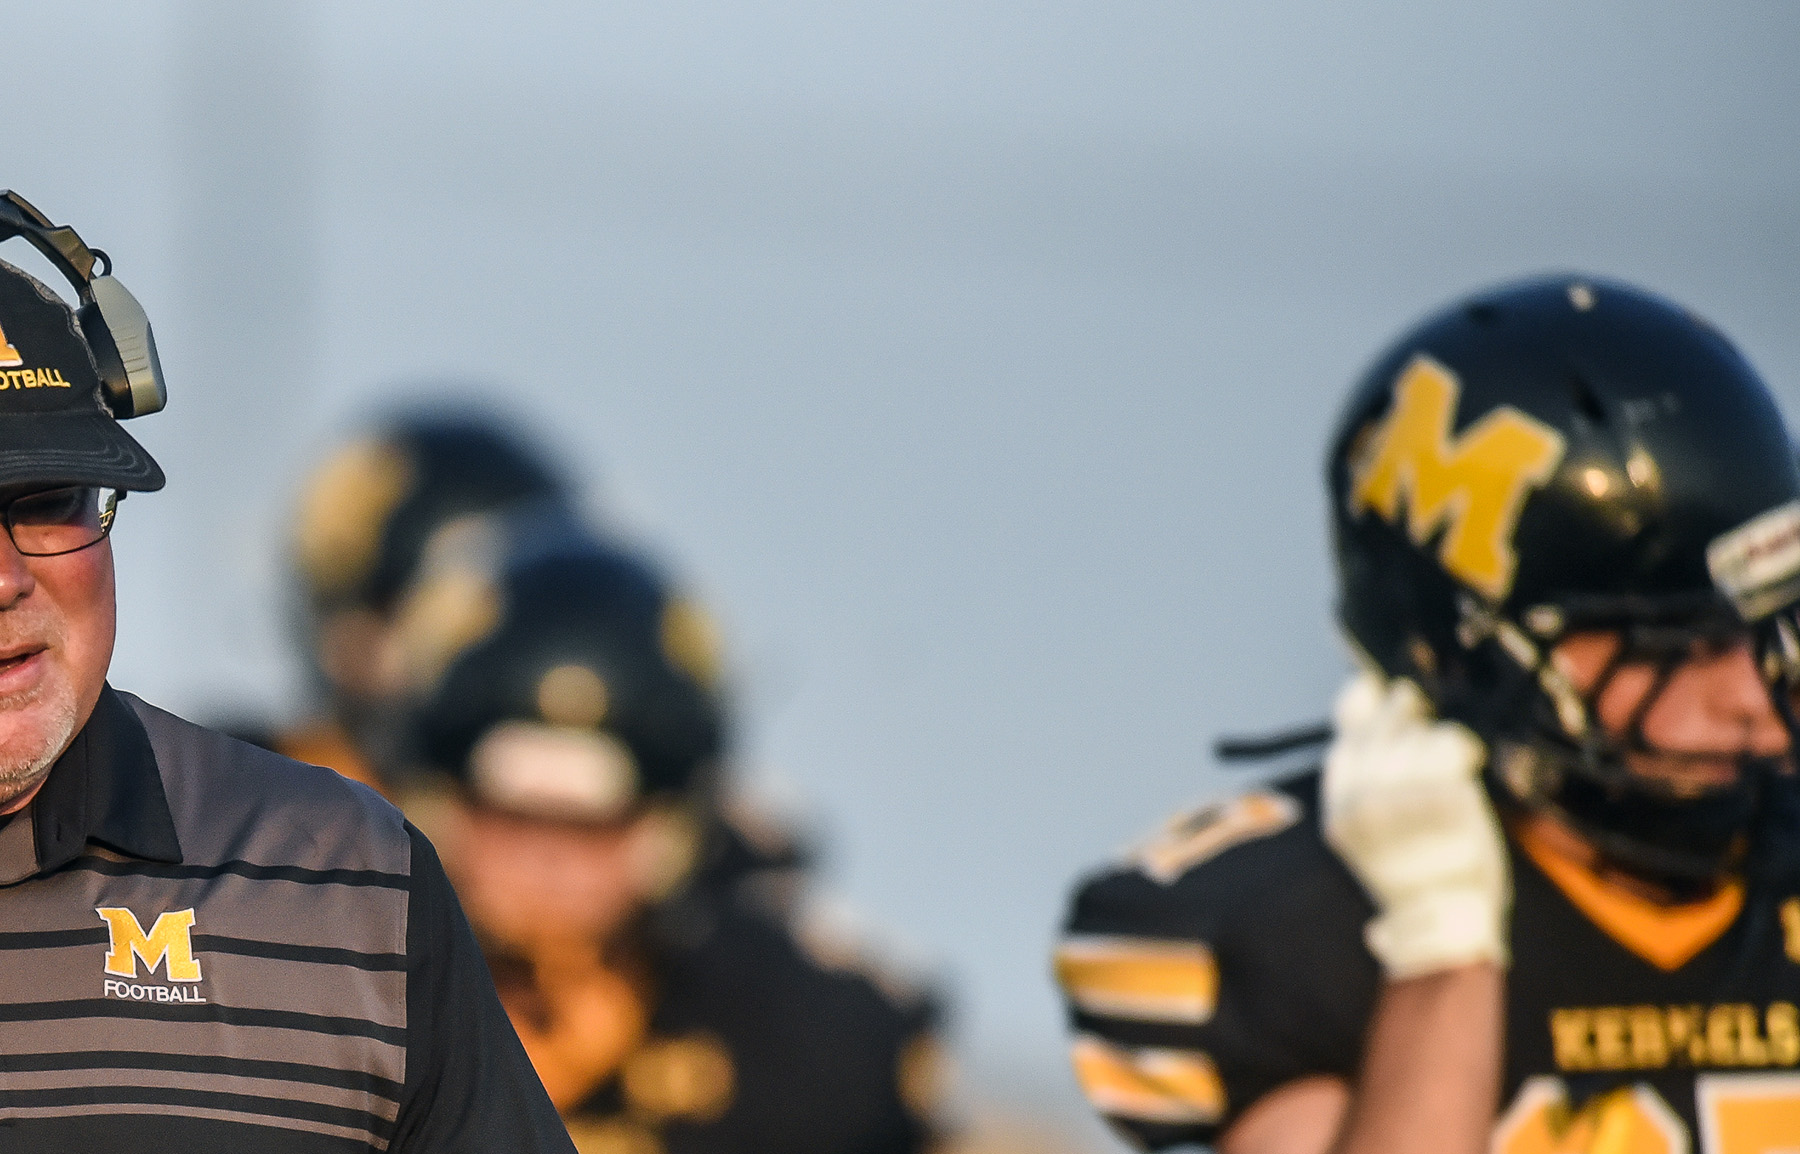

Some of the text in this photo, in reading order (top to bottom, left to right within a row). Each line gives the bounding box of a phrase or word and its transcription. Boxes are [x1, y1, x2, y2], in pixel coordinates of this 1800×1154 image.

[1348, 352, 1566, 603] M
[95, 907, 203, 982] M
[104, 979, 207, 1003] FOOTBALL
